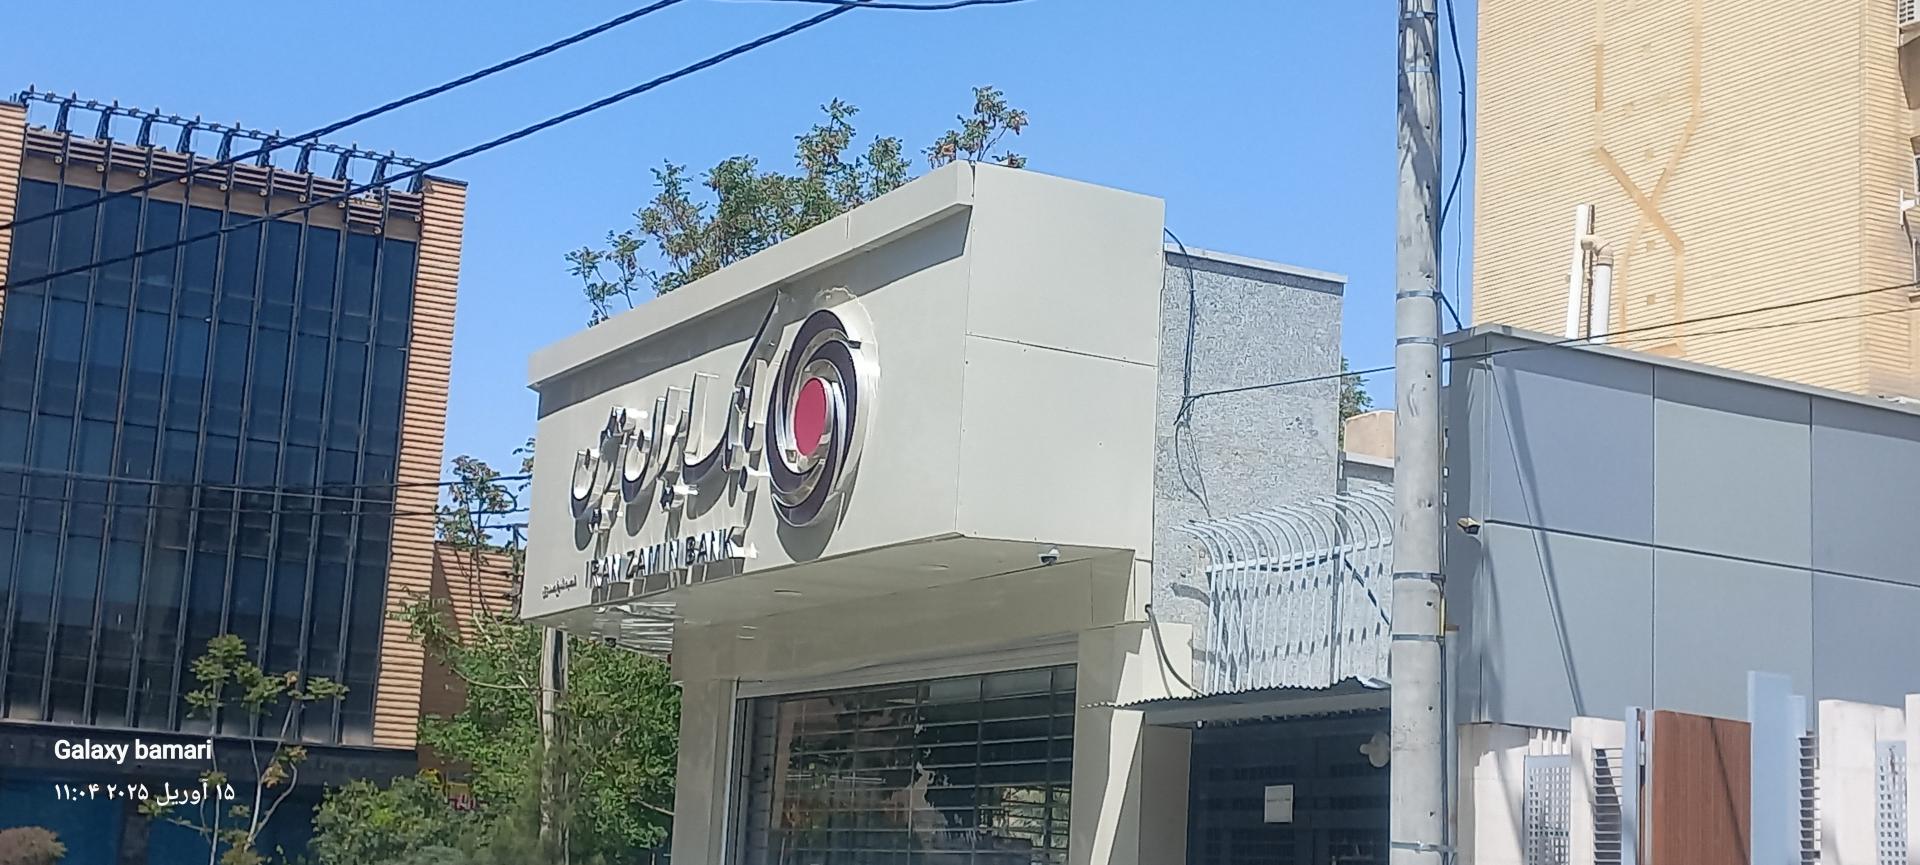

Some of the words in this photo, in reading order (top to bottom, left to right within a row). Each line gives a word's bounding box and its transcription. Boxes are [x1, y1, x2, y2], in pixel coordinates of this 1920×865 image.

[585, 553, 622, 588] IRAN
[626, 538, 679, 579] ZAMIN
[685, 529, 736, 566] BANK
